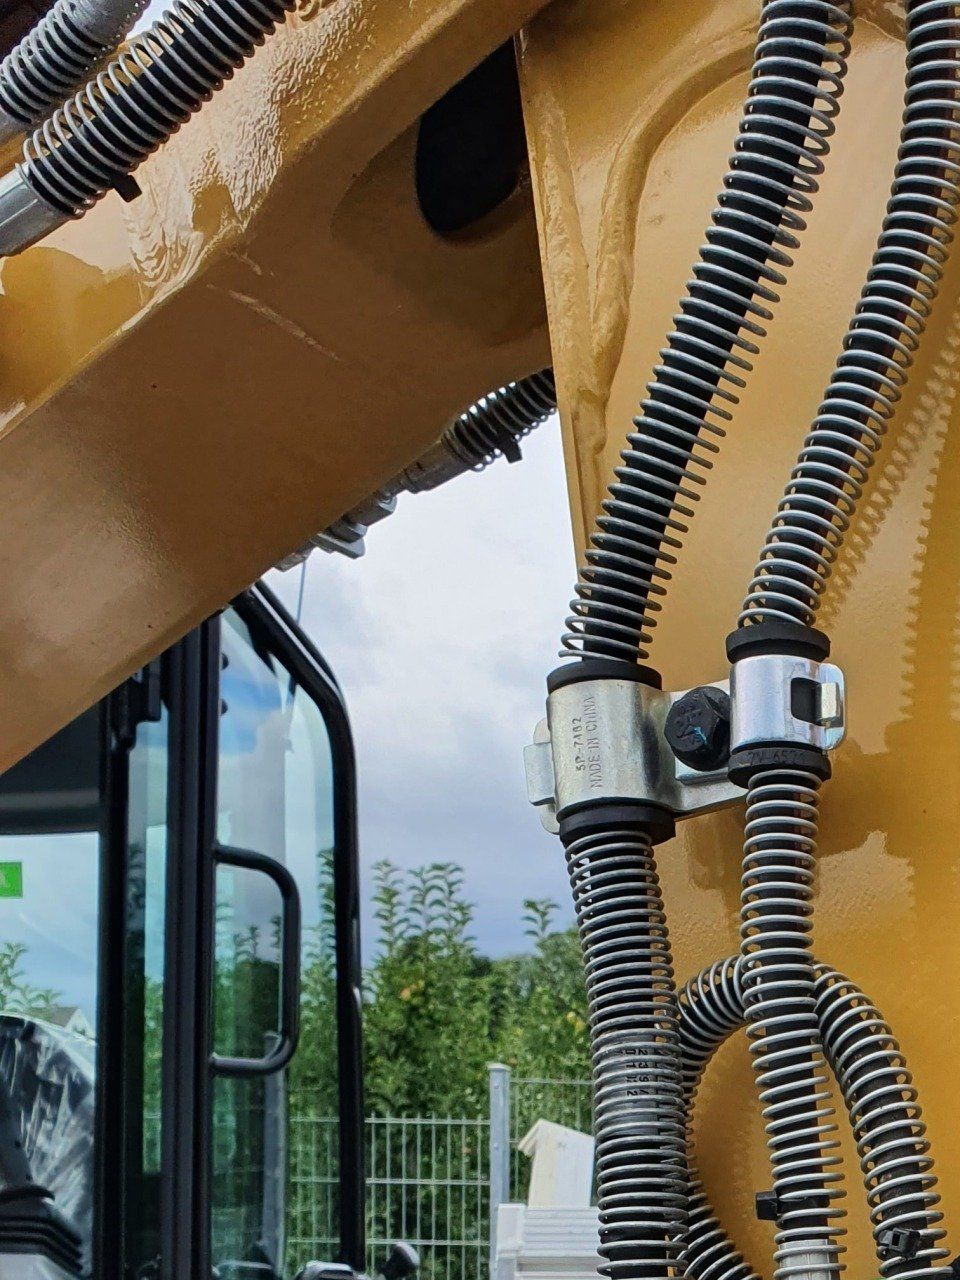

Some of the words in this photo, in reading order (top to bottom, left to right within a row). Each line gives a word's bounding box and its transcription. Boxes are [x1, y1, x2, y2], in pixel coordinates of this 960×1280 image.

[584, 695, 598, 732] CHINA
[587, 737, 600, 749] IN
[588, 754, 603, 788] MADE
